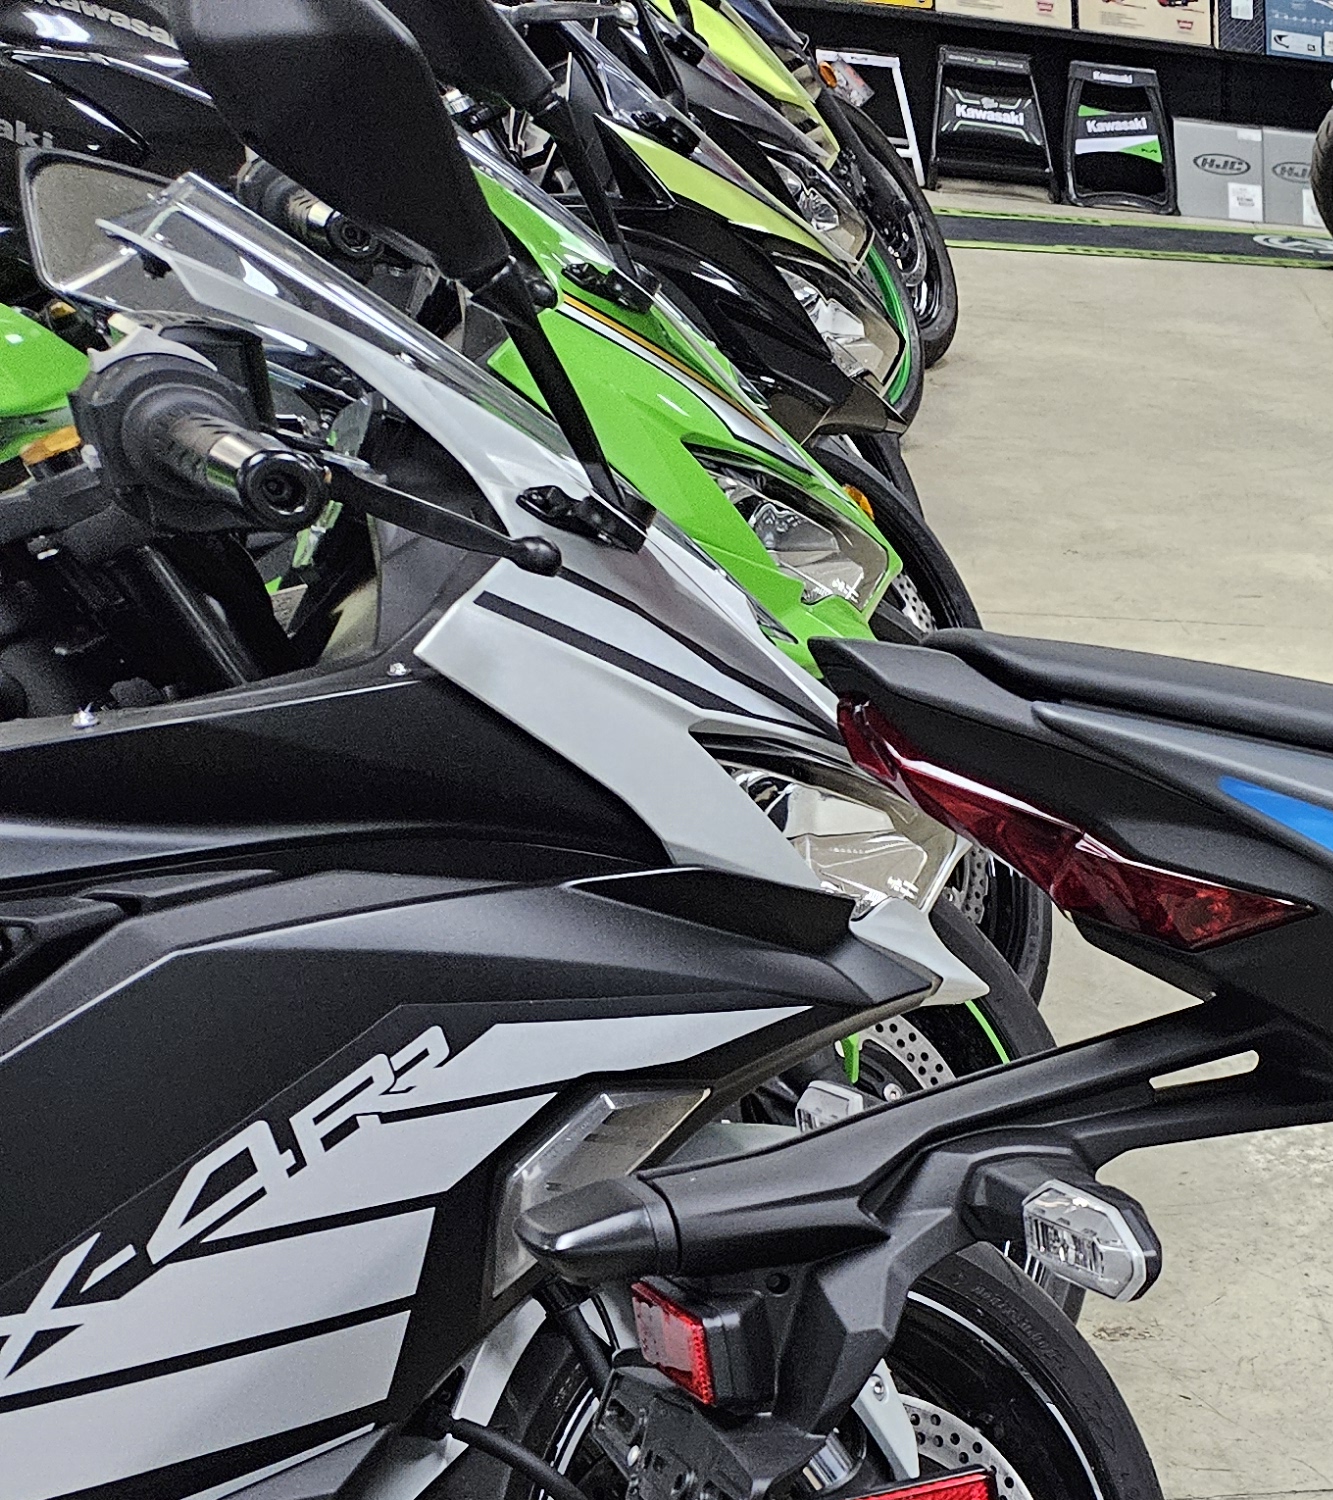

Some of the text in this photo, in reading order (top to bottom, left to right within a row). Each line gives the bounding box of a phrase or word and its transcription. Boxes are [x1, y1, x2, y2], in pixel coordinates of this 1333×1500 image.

[34, 0, 179, 50] awasa
[955, 103, 1025, 126] Kawasaki
[1085, 117, 1148, 133] Kawasaki
[1201, 157, 1244, 171] HJC
